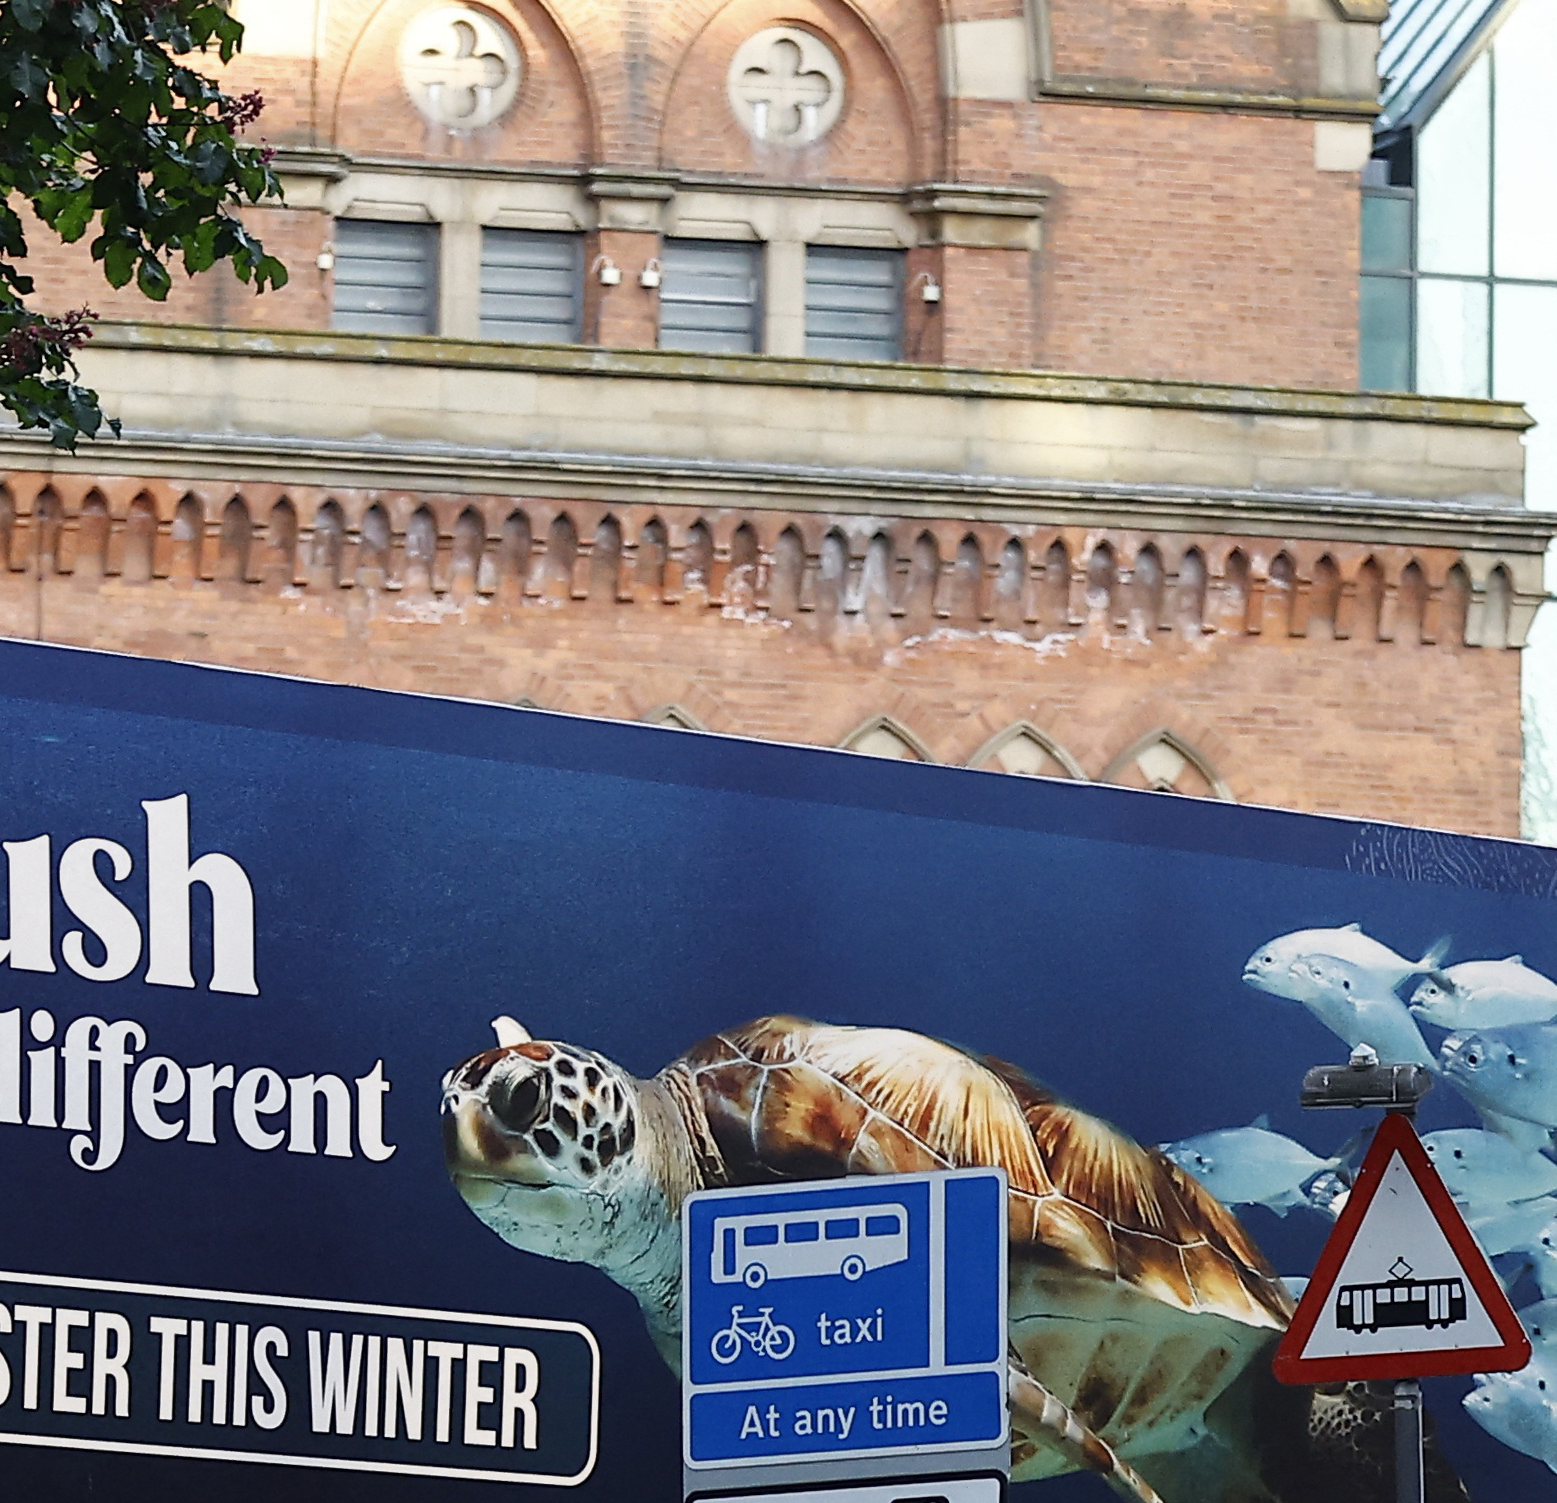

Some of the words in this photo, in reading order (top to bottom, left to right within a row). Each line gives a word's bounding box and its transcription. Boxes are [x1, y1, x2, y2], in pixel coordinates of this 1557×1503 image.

[817, 1308, 883, 1345] taxi
[149, 1316, 289, 1432] THIS
[307, 1329, 539, 1451] WINTER
[739, 1405, 780, 1440] At
[793, 1403, 855, 1439] any
[869, 1395, 948, 1429] time
